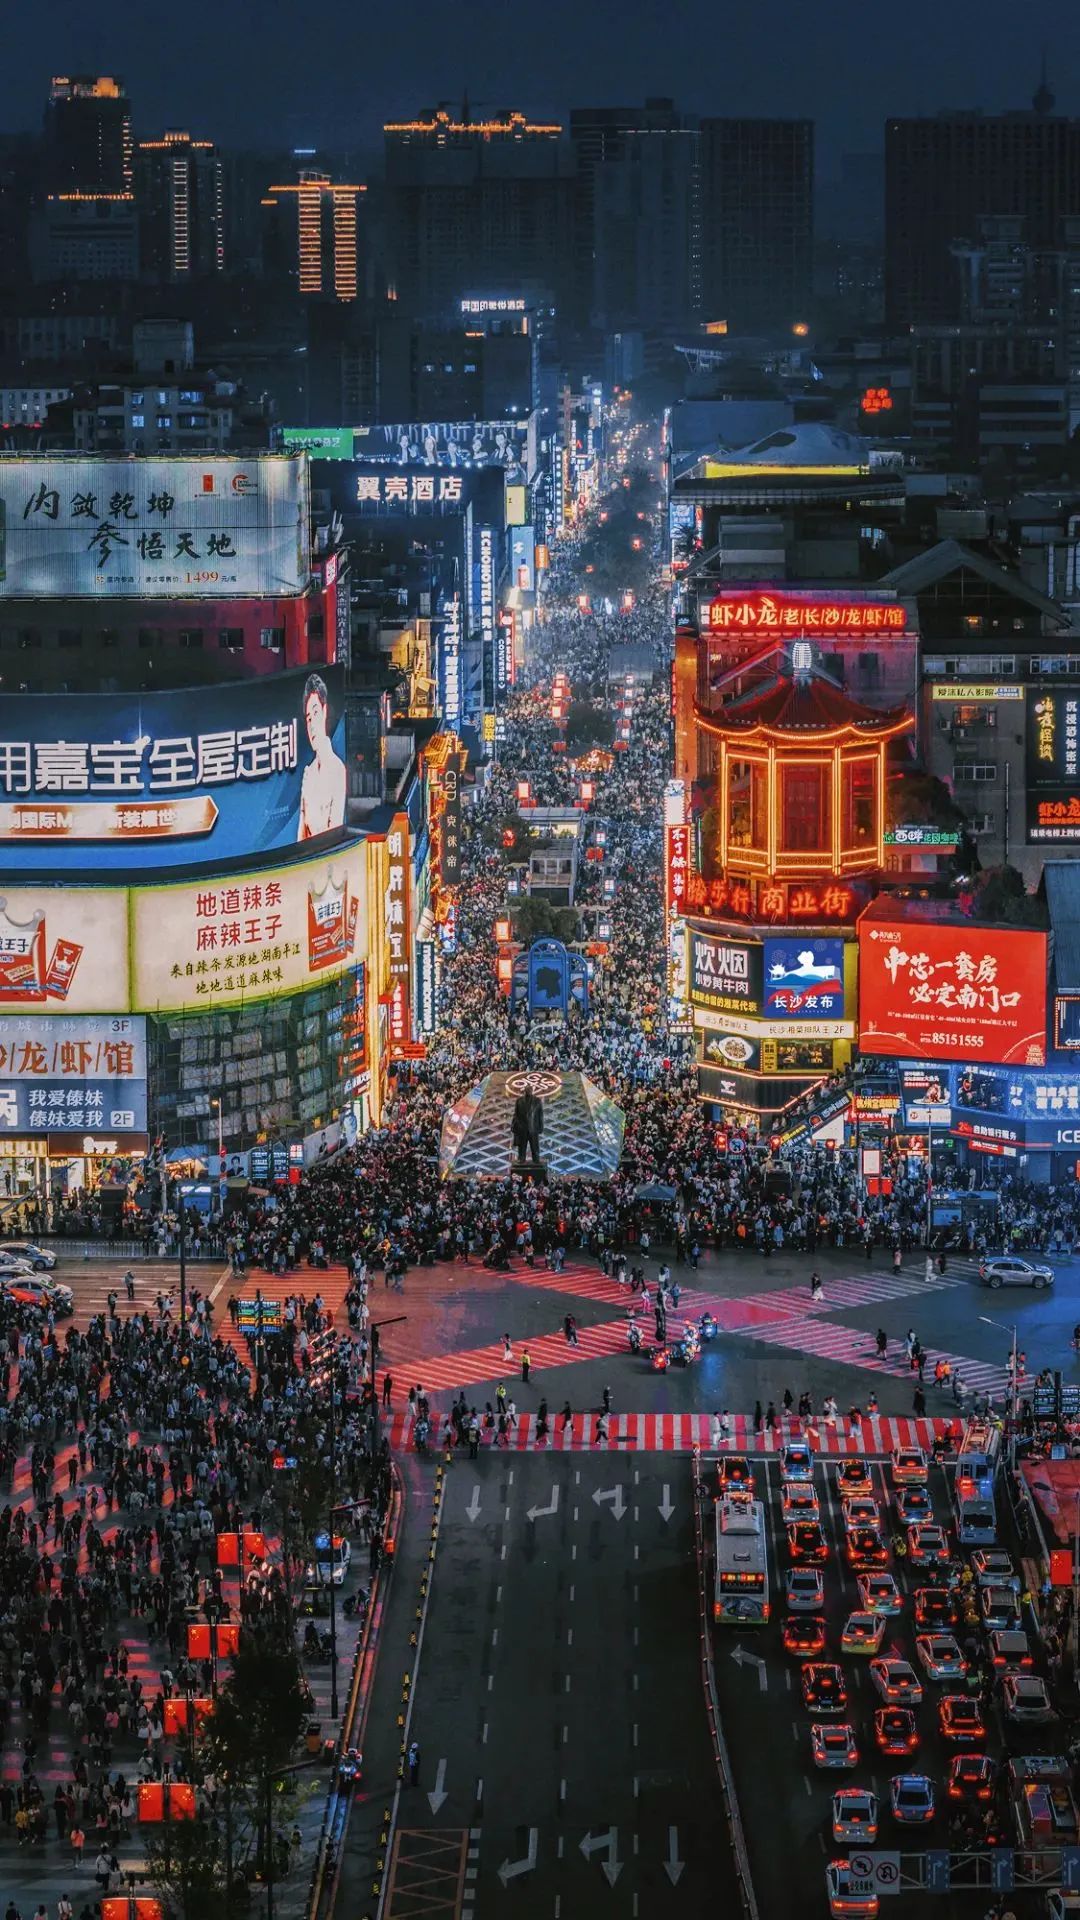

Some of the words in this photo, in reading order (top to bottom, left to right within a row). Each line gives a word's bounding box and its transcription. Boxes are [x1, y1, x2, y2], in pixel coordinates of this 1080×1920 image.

[22, 482, 175, 521] 内敛乾坤
[87, 520, 236, 568] 参悟天地
[184, 571, 219, 584] 1499
[445, 771, 457, 801] CRD
[196, 882, 283, 918] 地道辣条
[0, 937, 29, 953] 王子
[196, 915, 283, 952] 麻辣王子
[695, 941, 748, 978] 炊烟
[883, 945, 997, 984] 中芯一套房
[696, 974, 749, 995] 小炒黄牛肉
[774, 995, 834, 1008] 长沙发布
[909, 982, 1021, 1013] 必定南门口
[112, 1020, 130, 1032] 3F
[833, 1025, 844, 1034] 2F
[932, 1032, 984, 1048] 85151555
[114, 1114, 131, 1125] 2F
